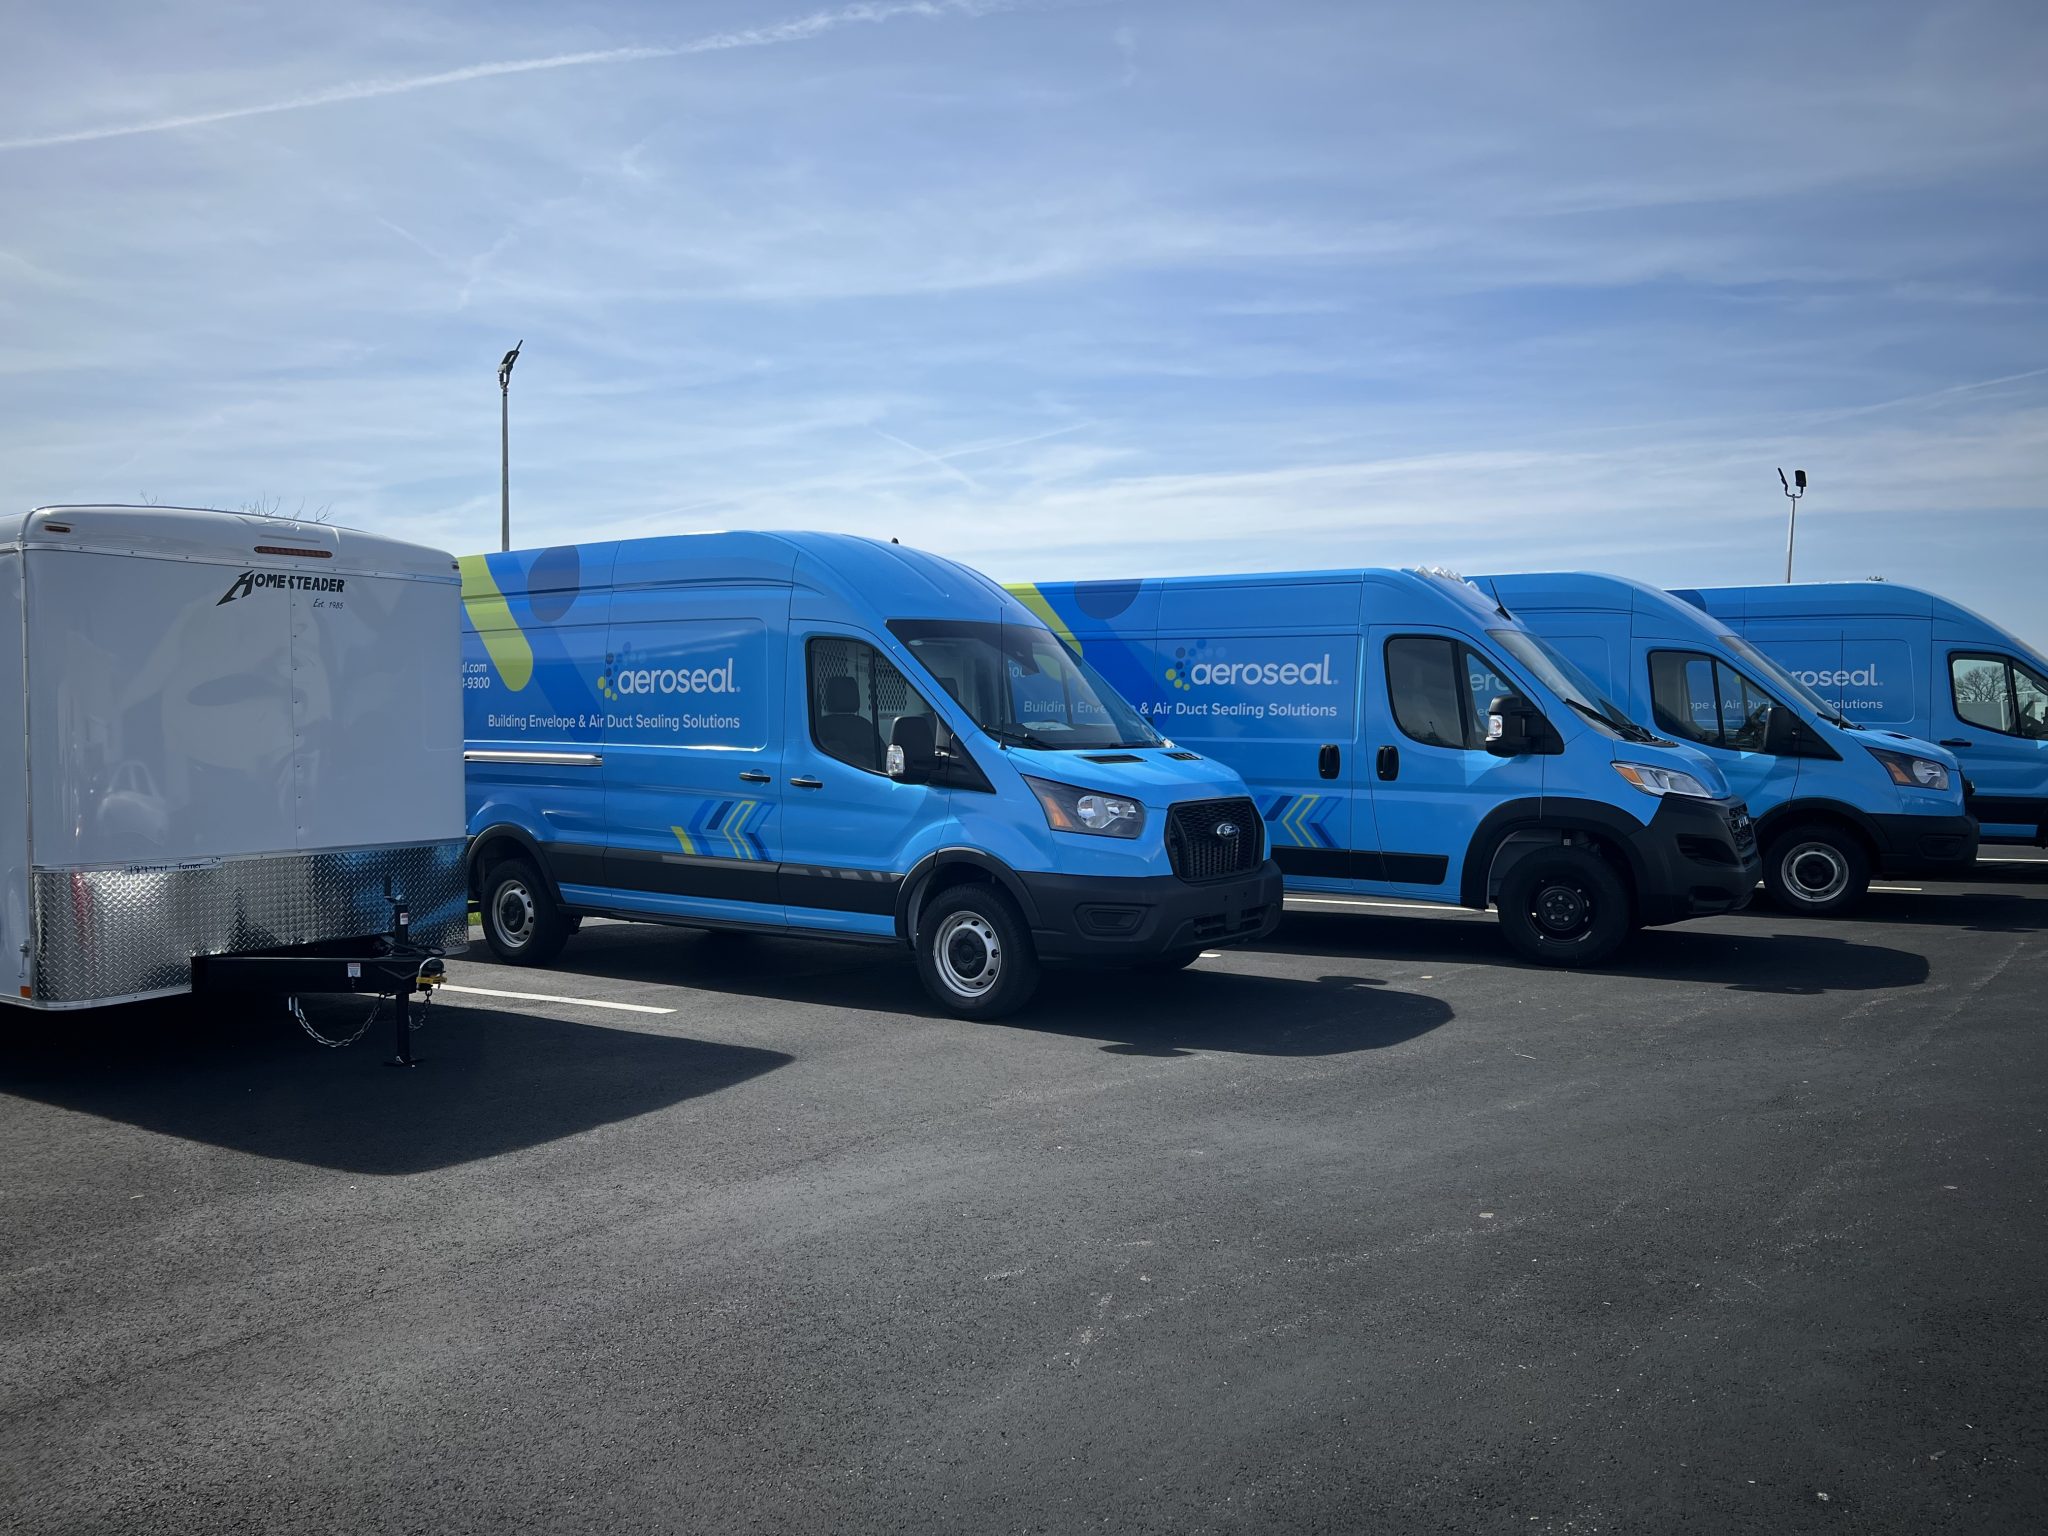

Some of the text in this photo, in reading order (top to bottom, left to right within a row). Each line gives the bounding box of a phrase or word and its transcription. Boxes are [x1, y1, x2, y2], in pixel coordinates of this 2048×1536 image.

[617, 657, 735, 695] aeroseal
[1191, 653, 1332, 685] aeroseal
[1791, 663, 1878, 687] roseal
[1024, 700, 1073, 713] Buildin
[1139, 701, 1149, 715] &
[1153, 702, 1172, 715] Air
[1176, 702, 1208, 716] Duct
[1211, 702, 1265, 718] Sealing
[1268, 702, 1337, 717] Solutions
[488, 714, 740, 732] Building Envelope & Air Duct Sealing Solutions
